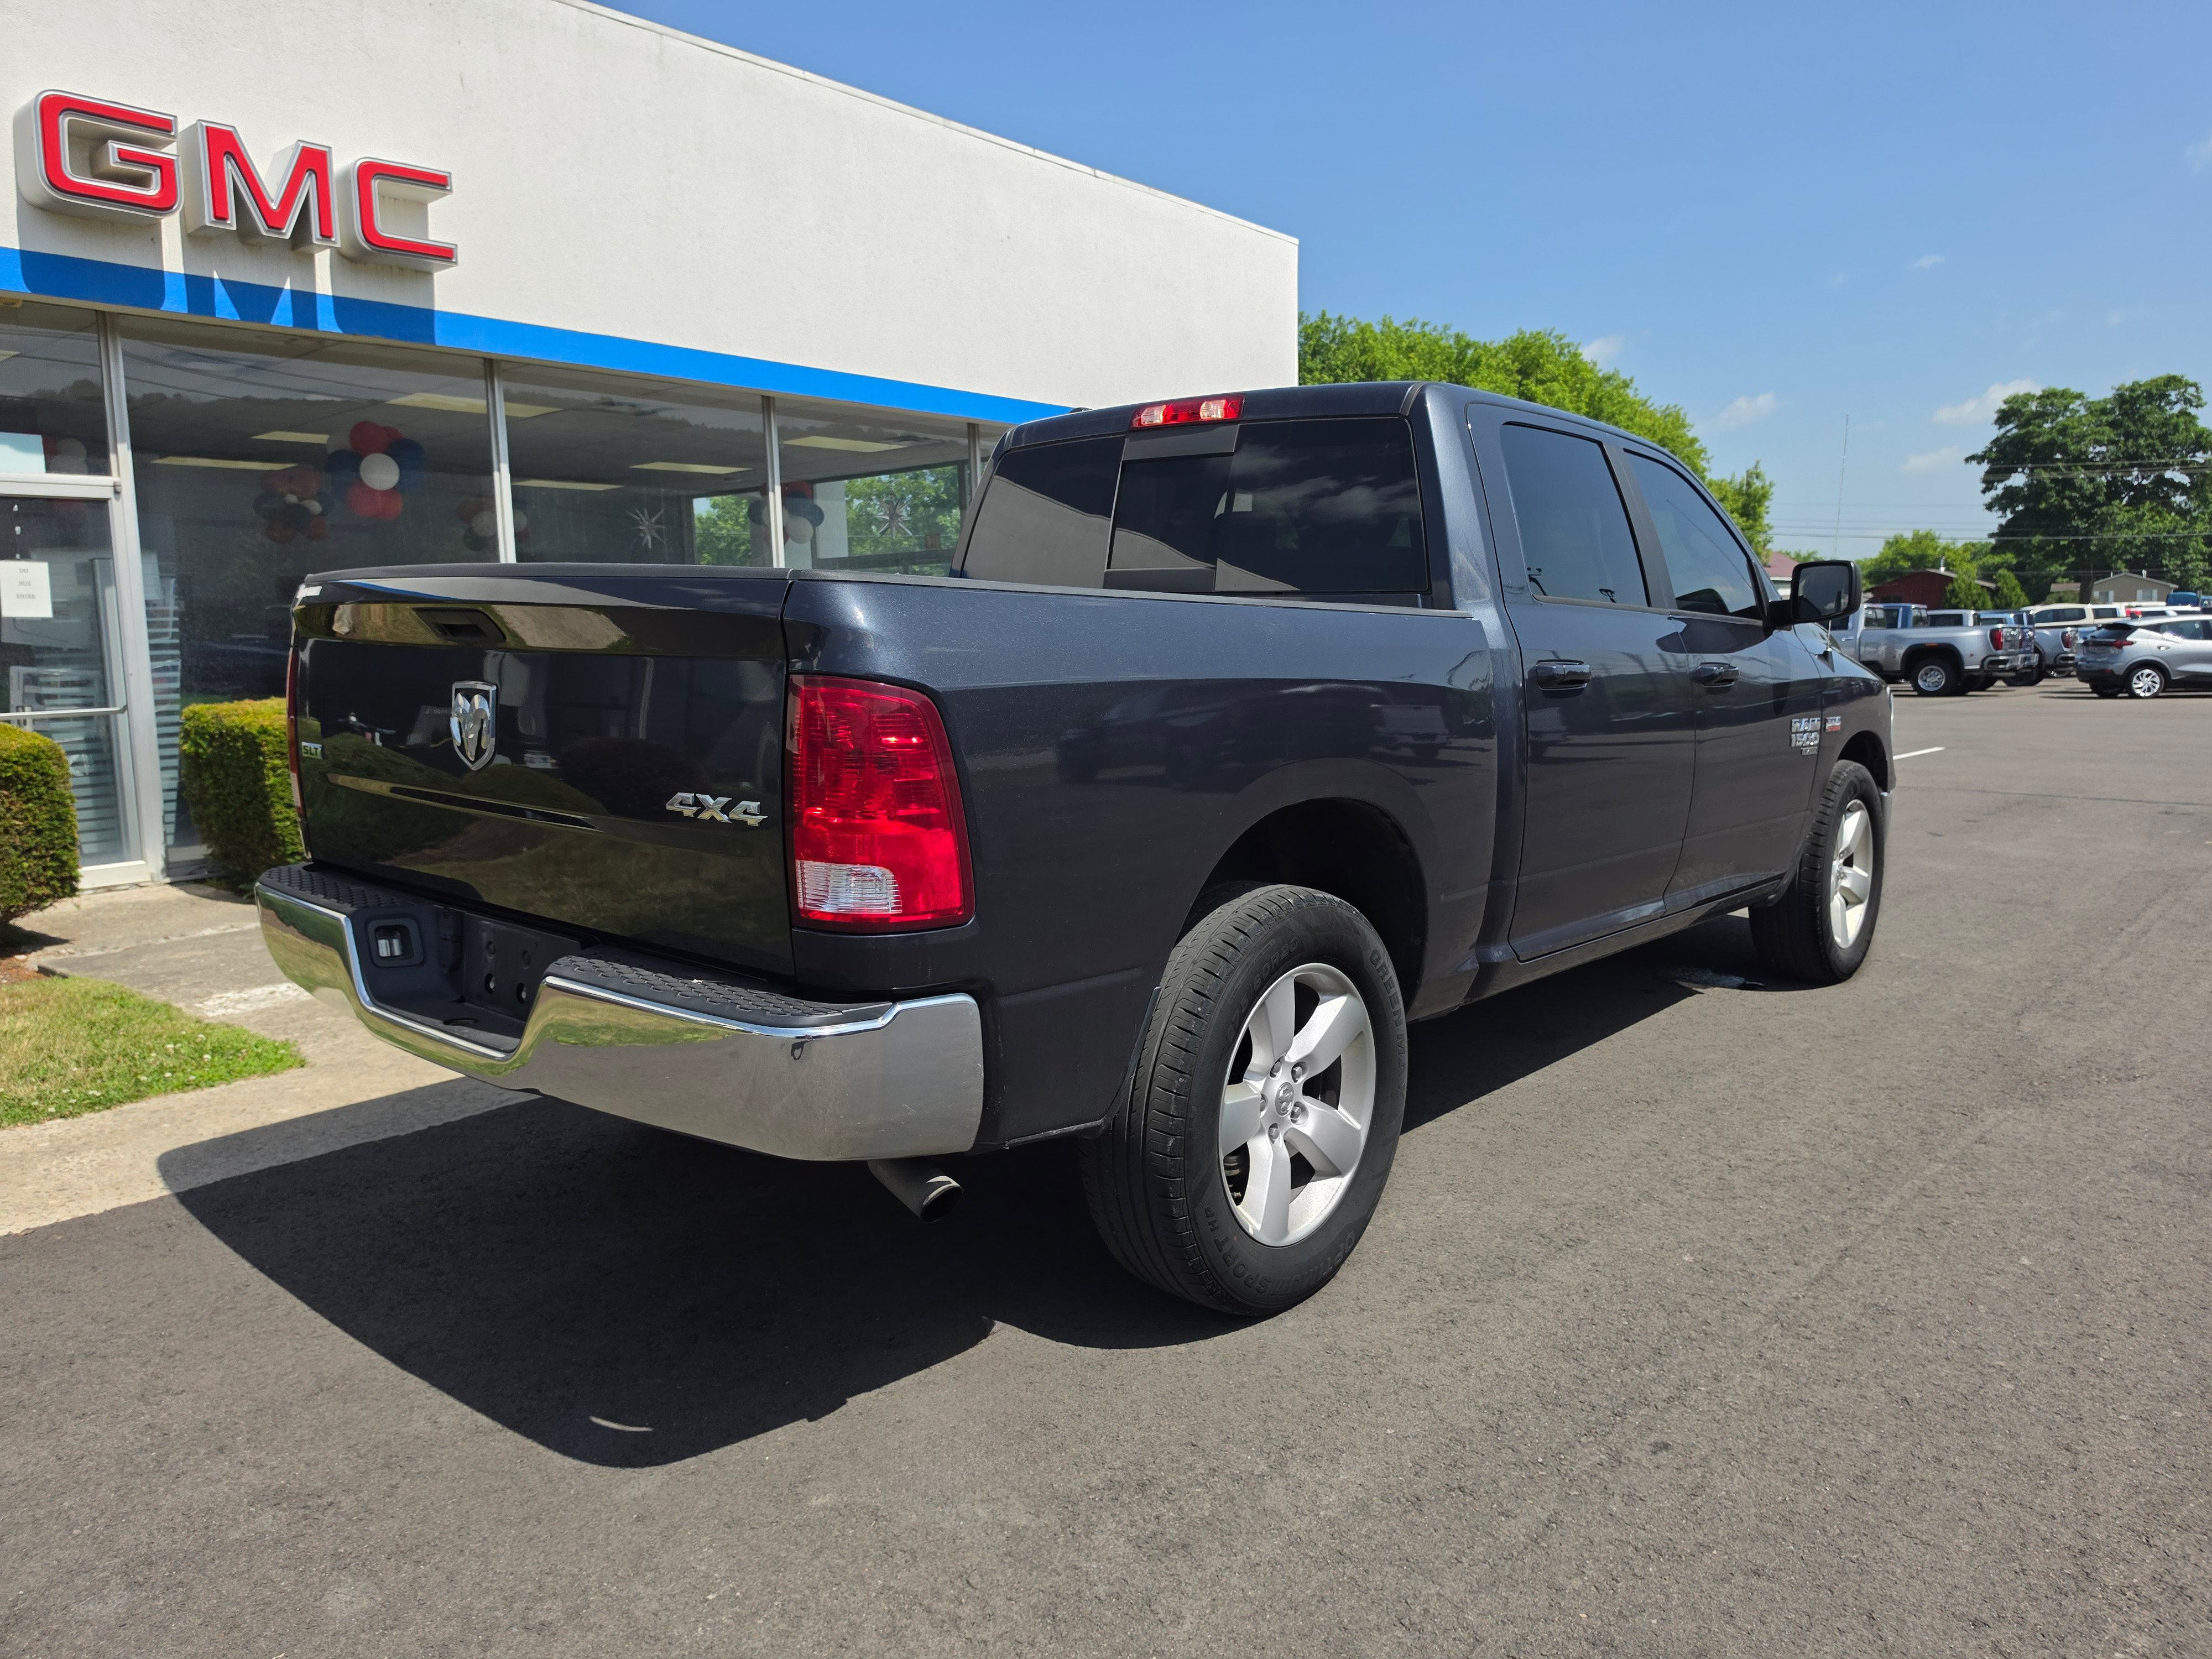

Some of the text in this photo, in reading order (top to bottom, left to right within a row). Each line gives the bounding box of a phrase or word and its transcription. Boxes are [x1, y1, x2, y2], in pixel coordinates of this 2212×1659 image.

[33, 88, 459, 269] GMC
[303, 745, 319, 757] SLT
[1369, 948, 1406, 1100] GREEN MAX
[1204, 1205, 1356, 1296] OPTIMUM SPORT HP
